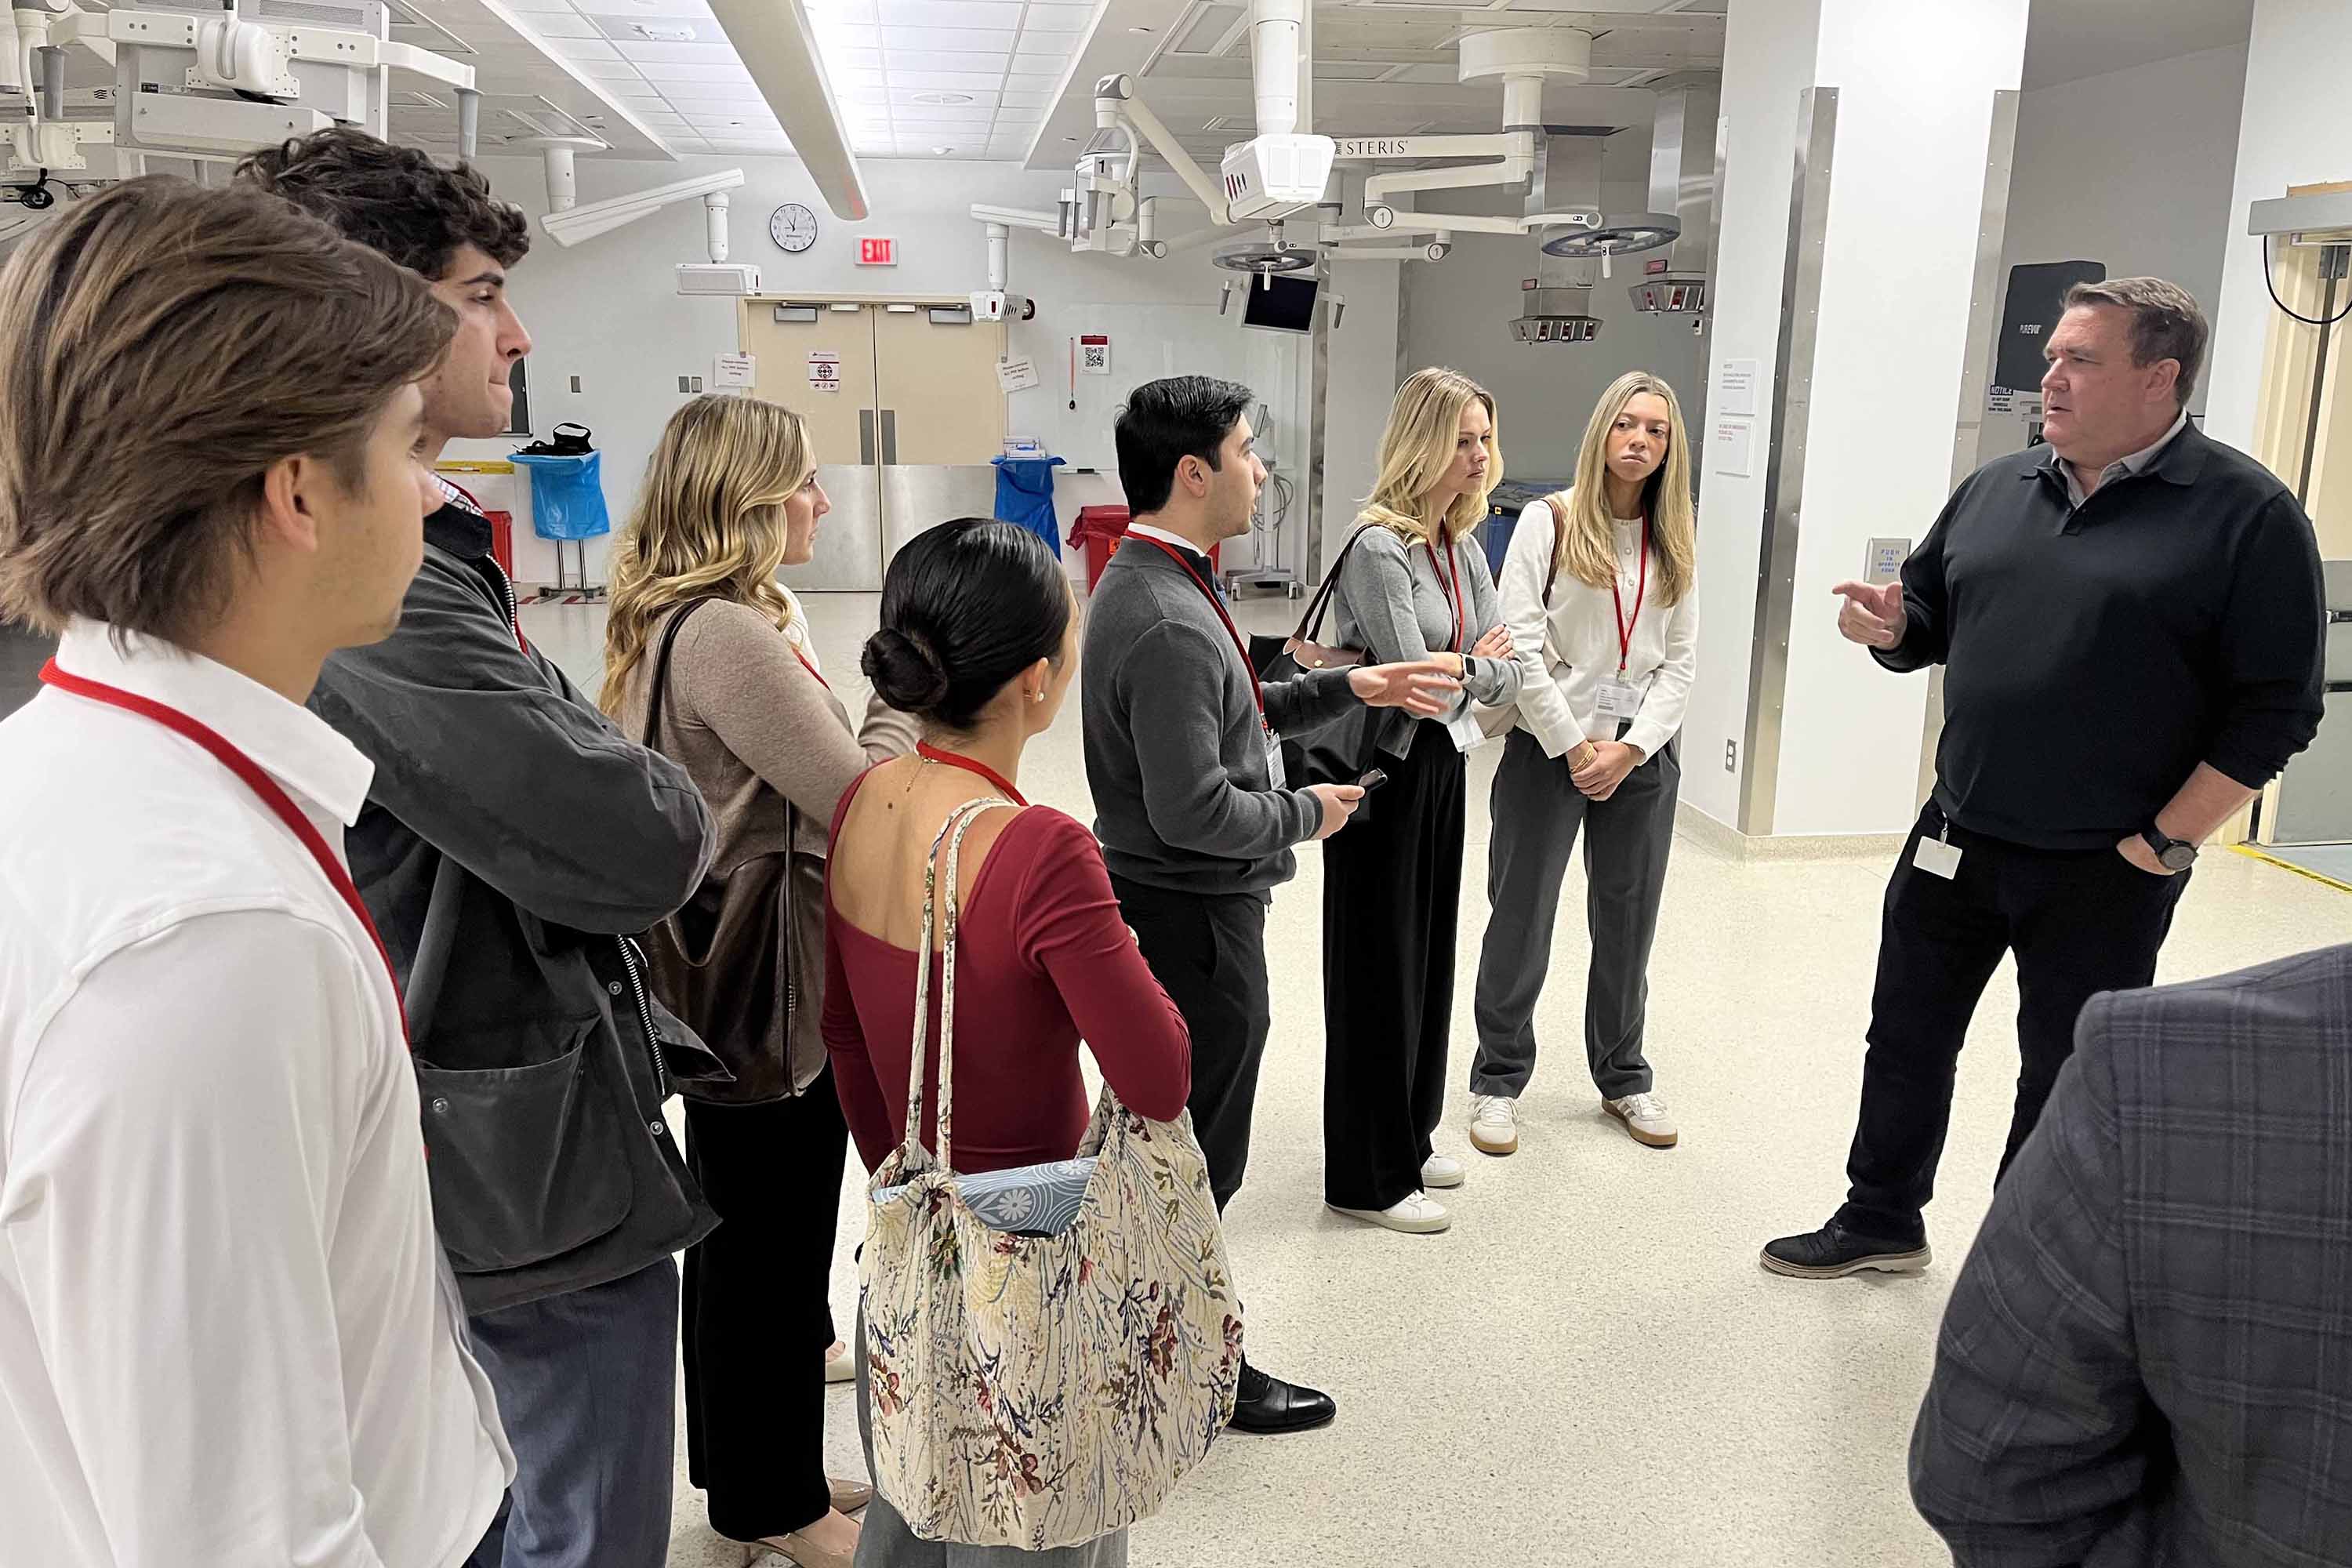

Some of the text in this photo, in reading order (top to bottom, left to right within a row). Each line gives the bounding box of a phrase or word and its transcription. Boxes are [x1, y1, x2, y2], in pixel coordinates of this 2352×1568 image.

[1347, 140, 1405, 154] STERIS
[1098, 159, 1105, 173] 1
[1380, 212, 1385, 223] 1
[862, 238, 891, 263] EXIT
